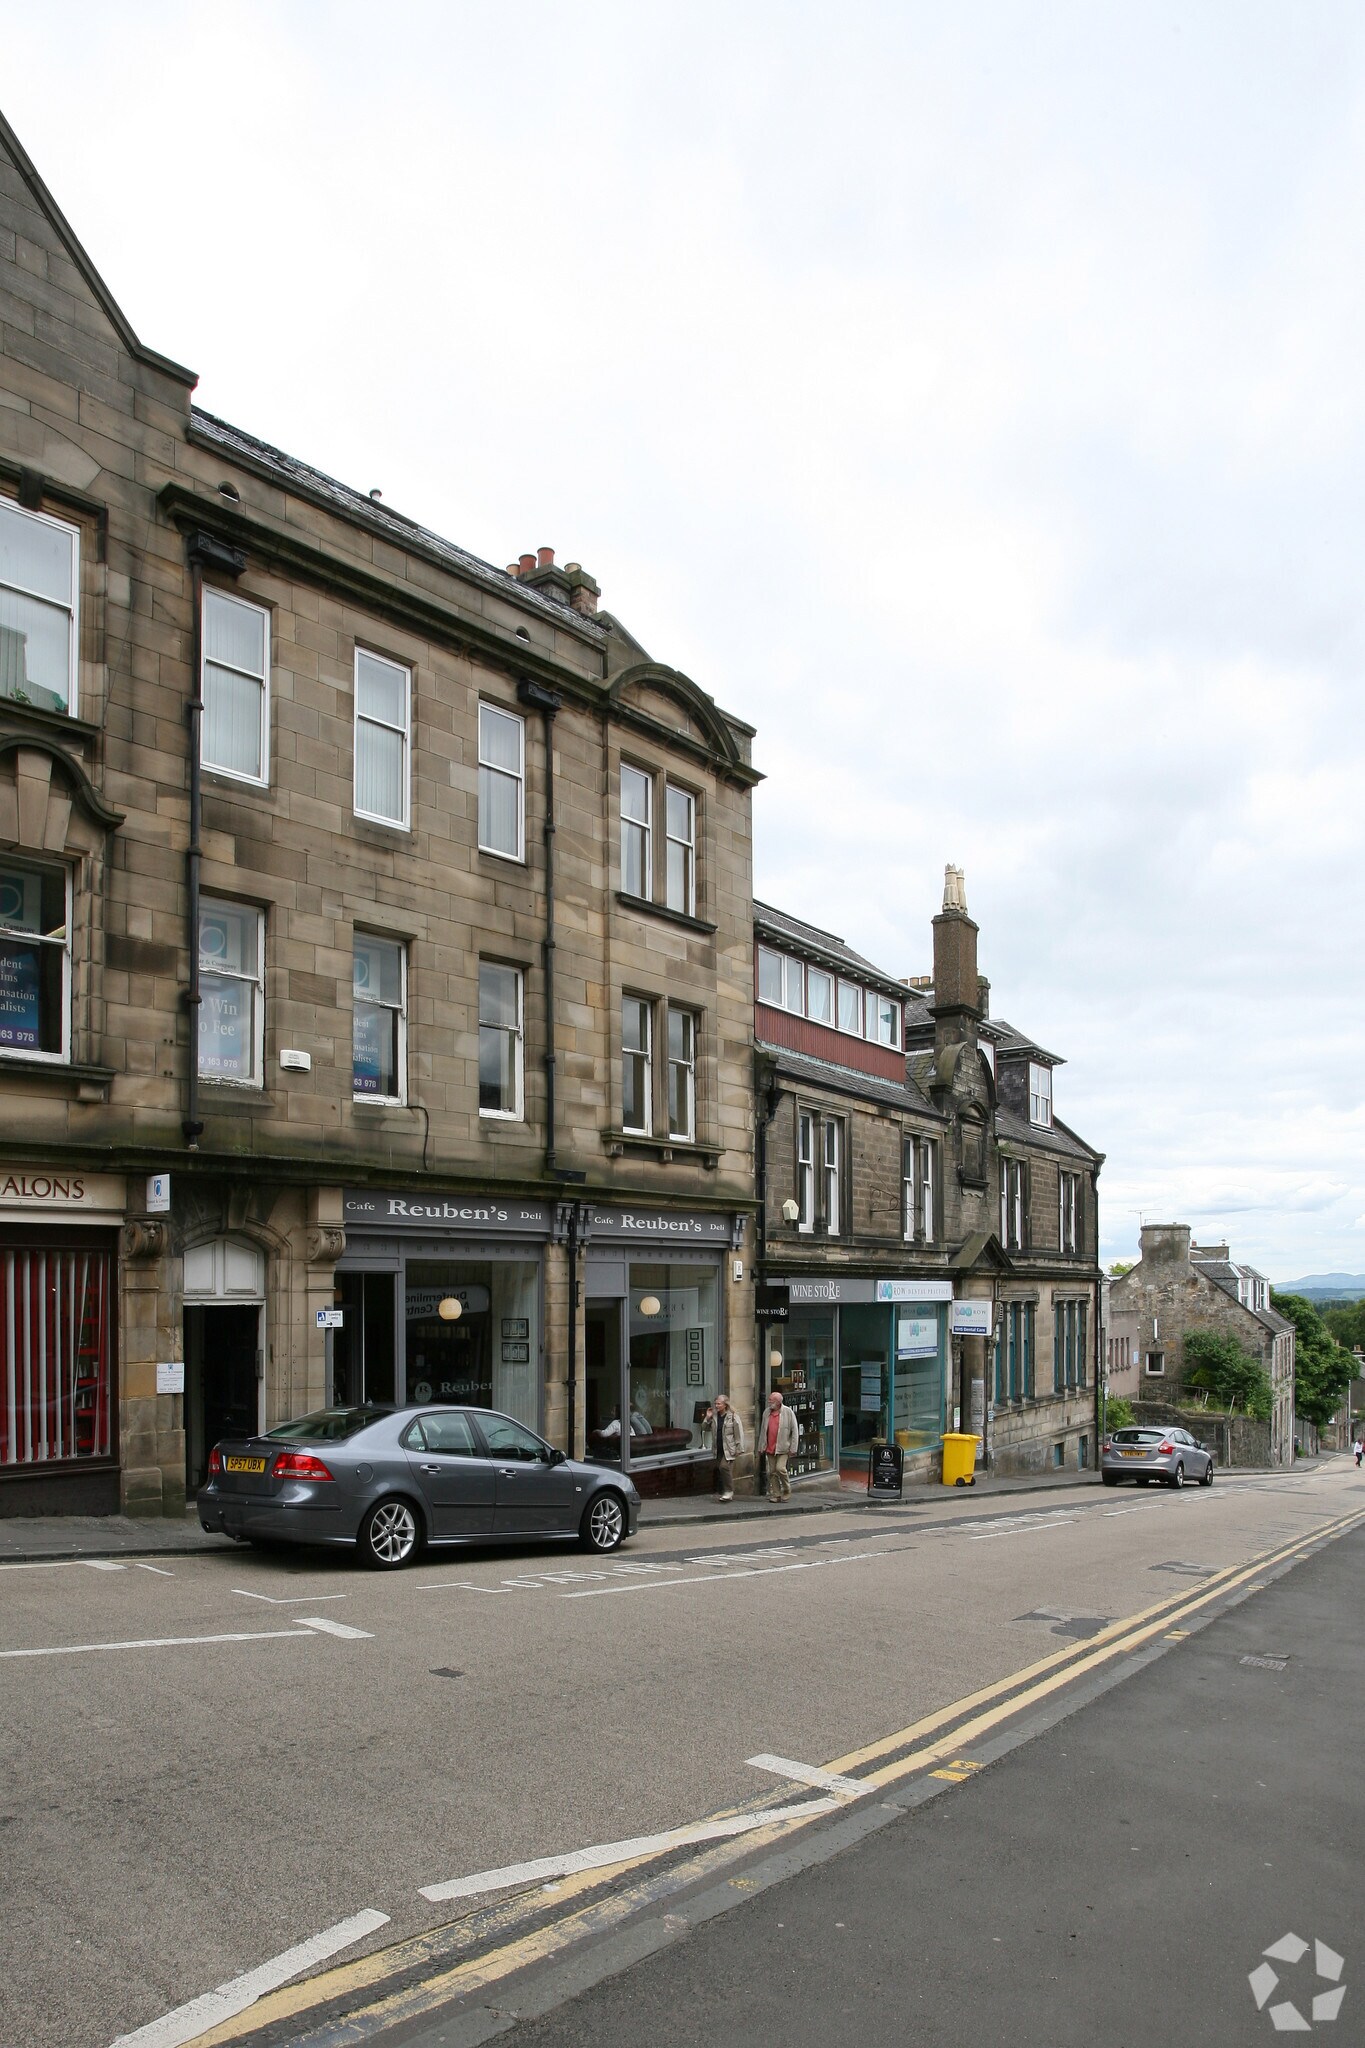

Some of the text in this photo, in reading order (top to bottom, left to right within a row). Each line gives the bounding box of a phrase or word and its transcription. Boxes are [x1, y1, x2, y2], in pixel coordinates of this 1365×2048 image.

[0, 957, 22, 969] dent
[0, 989, 35, 1001] nsation
[211, 998, 238, 1015] Win
[213, 1021, 235, 1036] Fee
[0, 1030, 35, 1042] 63 978
[207, 1057, 221, 1066] 163
[223, 1059, 238, 1068] 978
[364, 1080, 377, 1088] 978
[0, 1176, 85, 1199] ALONS
[346, 1199, 542, 1221] Cafe Reuben's Deli
[594, 1214, 725, 1232] Cafe Reuben's Deli
[792, 1285, 813, 1298] WINE
[230, 1458, 262, 1470] SP57 UBX
[459, 1565, 684, 1593] LOADING
